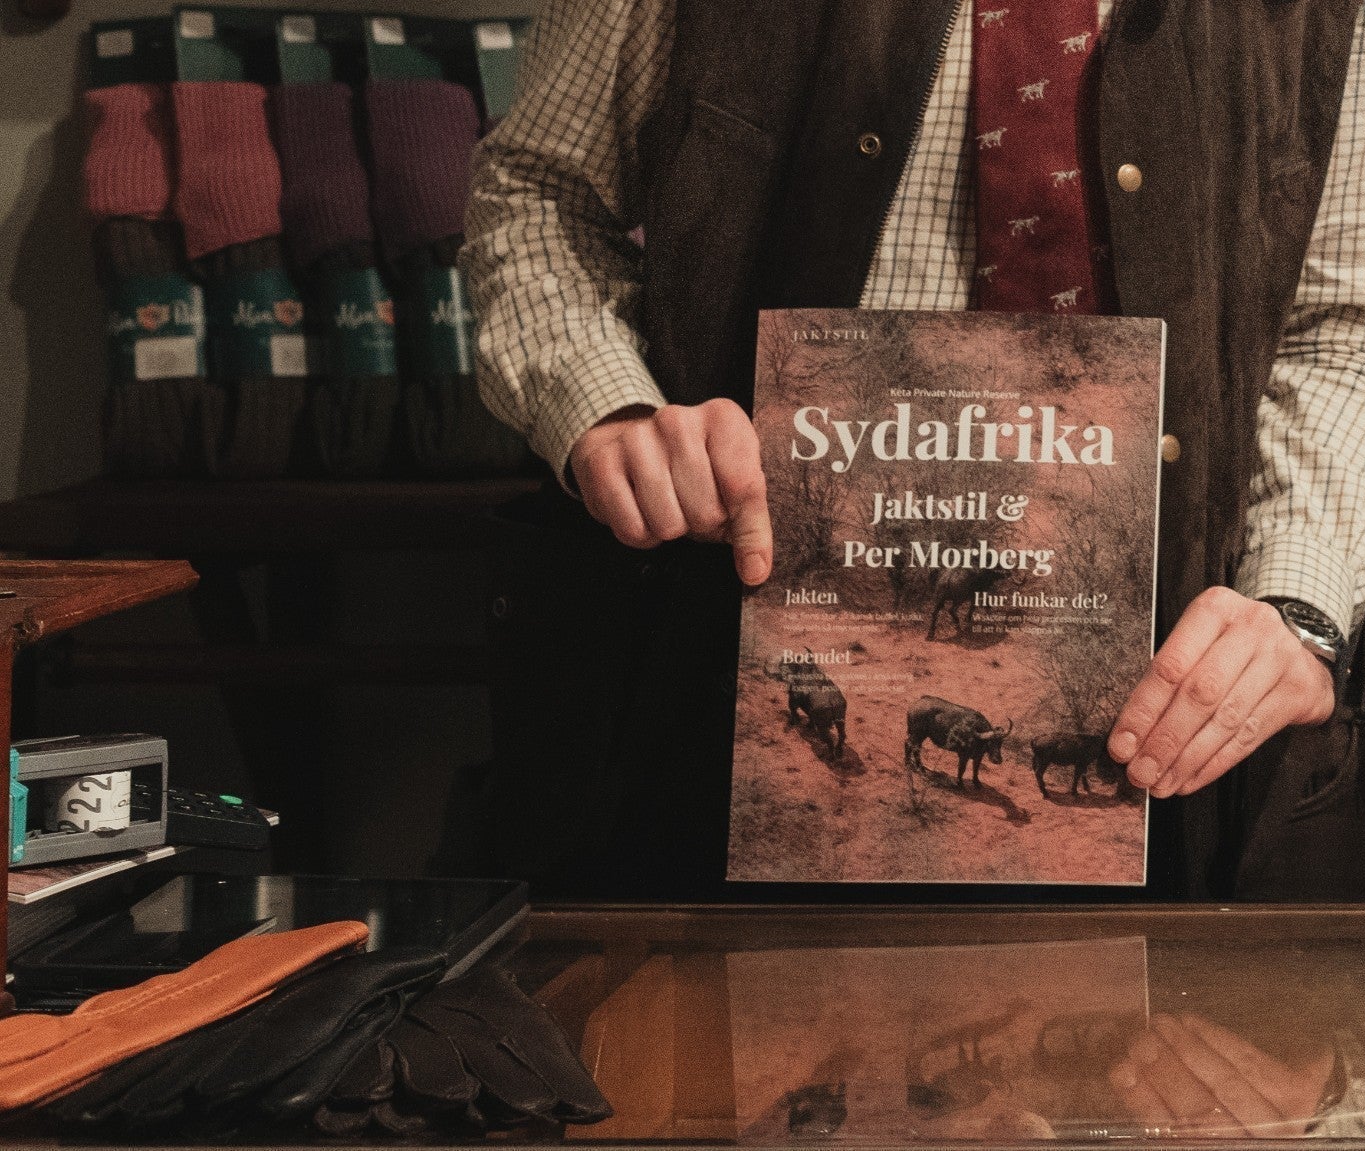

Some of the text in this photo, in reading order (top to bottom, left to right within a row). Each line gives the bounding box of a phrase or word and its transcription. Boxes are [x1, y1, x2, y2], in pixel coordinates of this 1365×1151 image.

[791, 330, 869, 343] JAKTSTIL
[949, 389, 981, 399] Nature
[791, 403, 1117, 473] Sydafrika
[871, 491, 1029, 525] Jaktstil &
[843, 540, 1055, 576] Per Morberg
[785, 588, 838, 607] Jakten
[974, 591, 1108, 609] Hur funkar det?
[783, 648, 852, 664] Boendet
